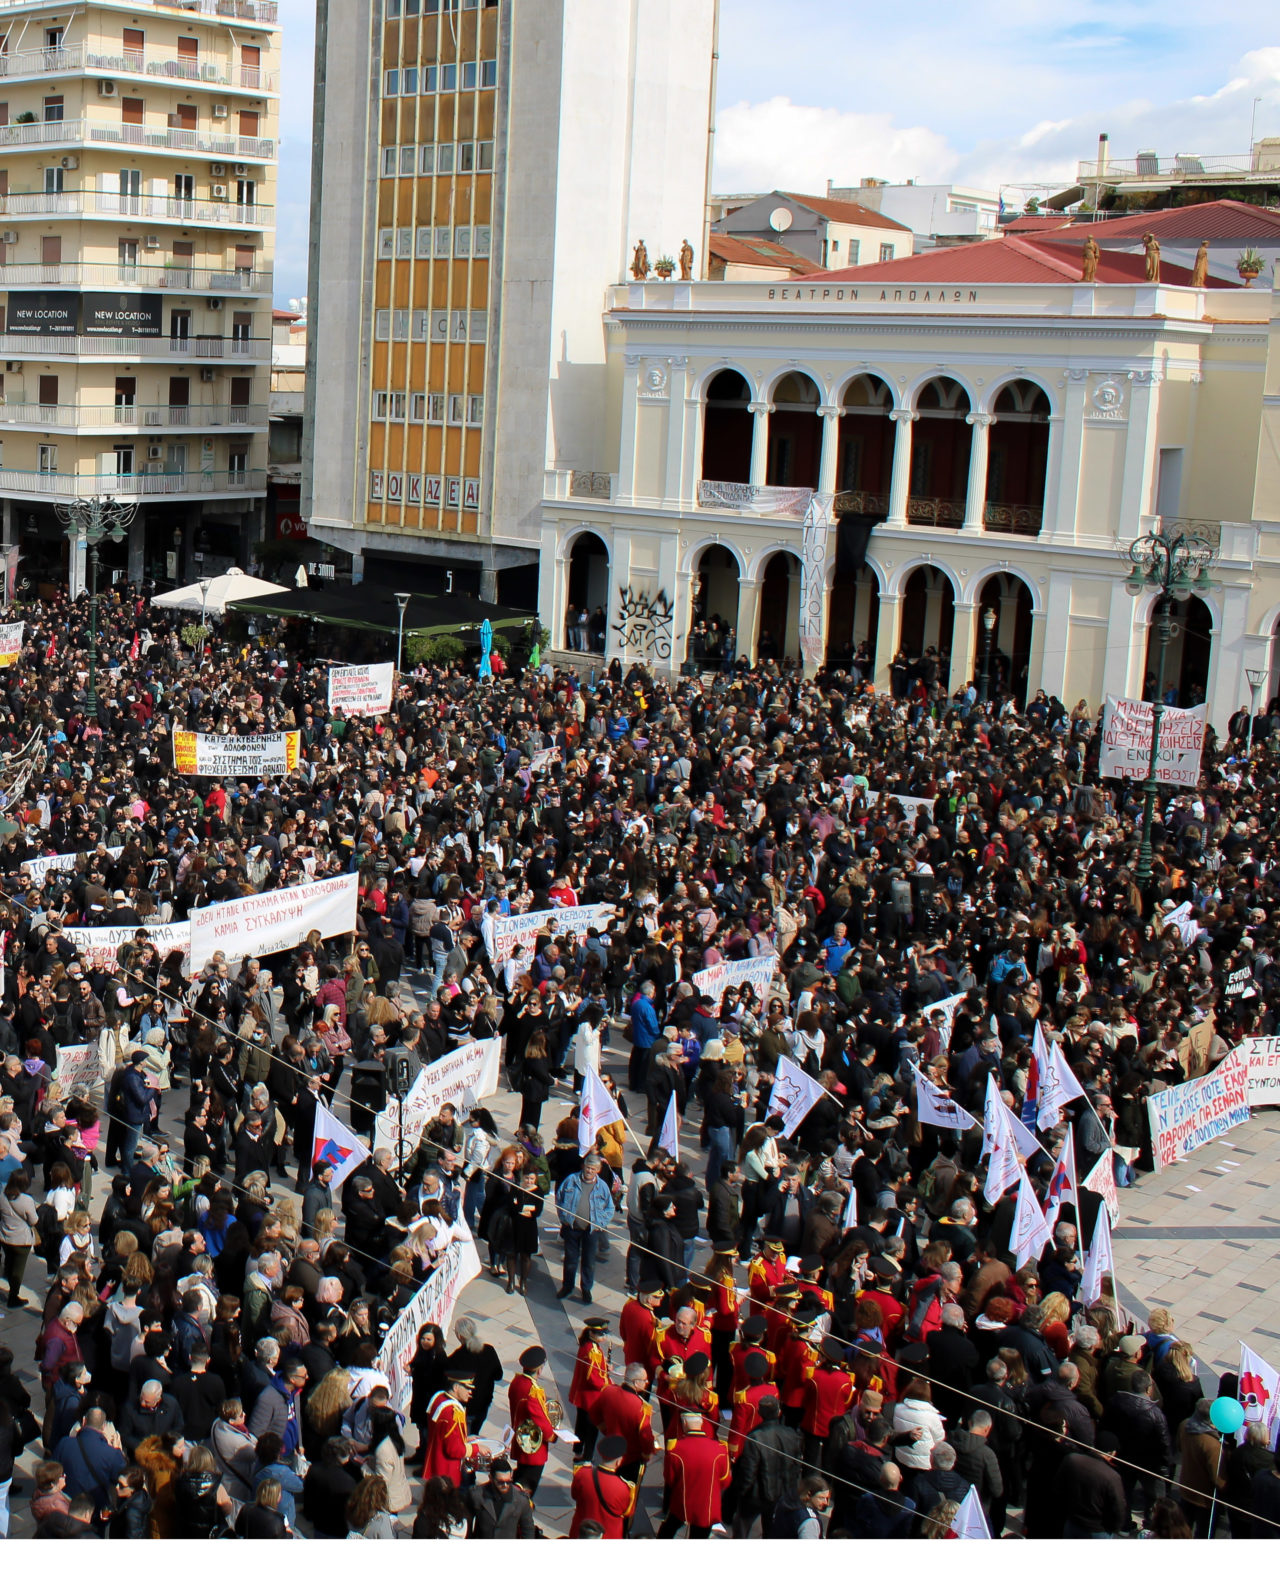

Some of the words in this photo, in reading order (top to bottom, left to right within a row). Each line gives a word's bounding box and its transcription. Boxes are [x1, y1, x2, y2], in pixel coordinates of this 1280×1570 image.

[768, 289, 858, 300] ΘΕΑΤΡΟΝ
[880, 290, 977, 302] ΑΠΟΛΛΩΝ
[17, 310, 33, 318] NEW
[34, 310, 68, 318] LOCATION
[94, 311, 113, 319] NEW
[115, 312, 152, 320] LOCATION
[236, 733, 282, 742] ΚΥΒΕΡΝΗΣΗ
[223, 744, 266, 752] ΔΟΛΟΦΟΝΩΝ
[213, 755, 247, 765] ΣΥΣΤΗΜΑ
[229, 764, 257, 774] ΣΕΞΙΣΜΟ
[216, 905, 240, 919] ΗΤΑΝΕ
[242, 895, 279, 913] ΑΤΥΧΗΜΑ
[280, 891, 299, 904] ΗΤΑΝ
[214, 922, 238, 937] ΚΑΜΙΑ
[245, 905, 303, 931] ΣΥΓΚΑΛΥΨΗ
[559, 909, 594, 921] ΚΕΡΔΟΥΣ
[1249, 1055, 1264, 1067] ΚΑΙ
[1159, 1114, 1197, 1150] ΠΑΡΟΥΜΕ
[1198, 1105, 1212, 1124] ΓΙΑ
[1212, 1088, 1244, 1116] ΣΕΝΑΝ
[1195, 1118, 1229, 1144] ΠΟΛΙΤΙΚΩΝ
